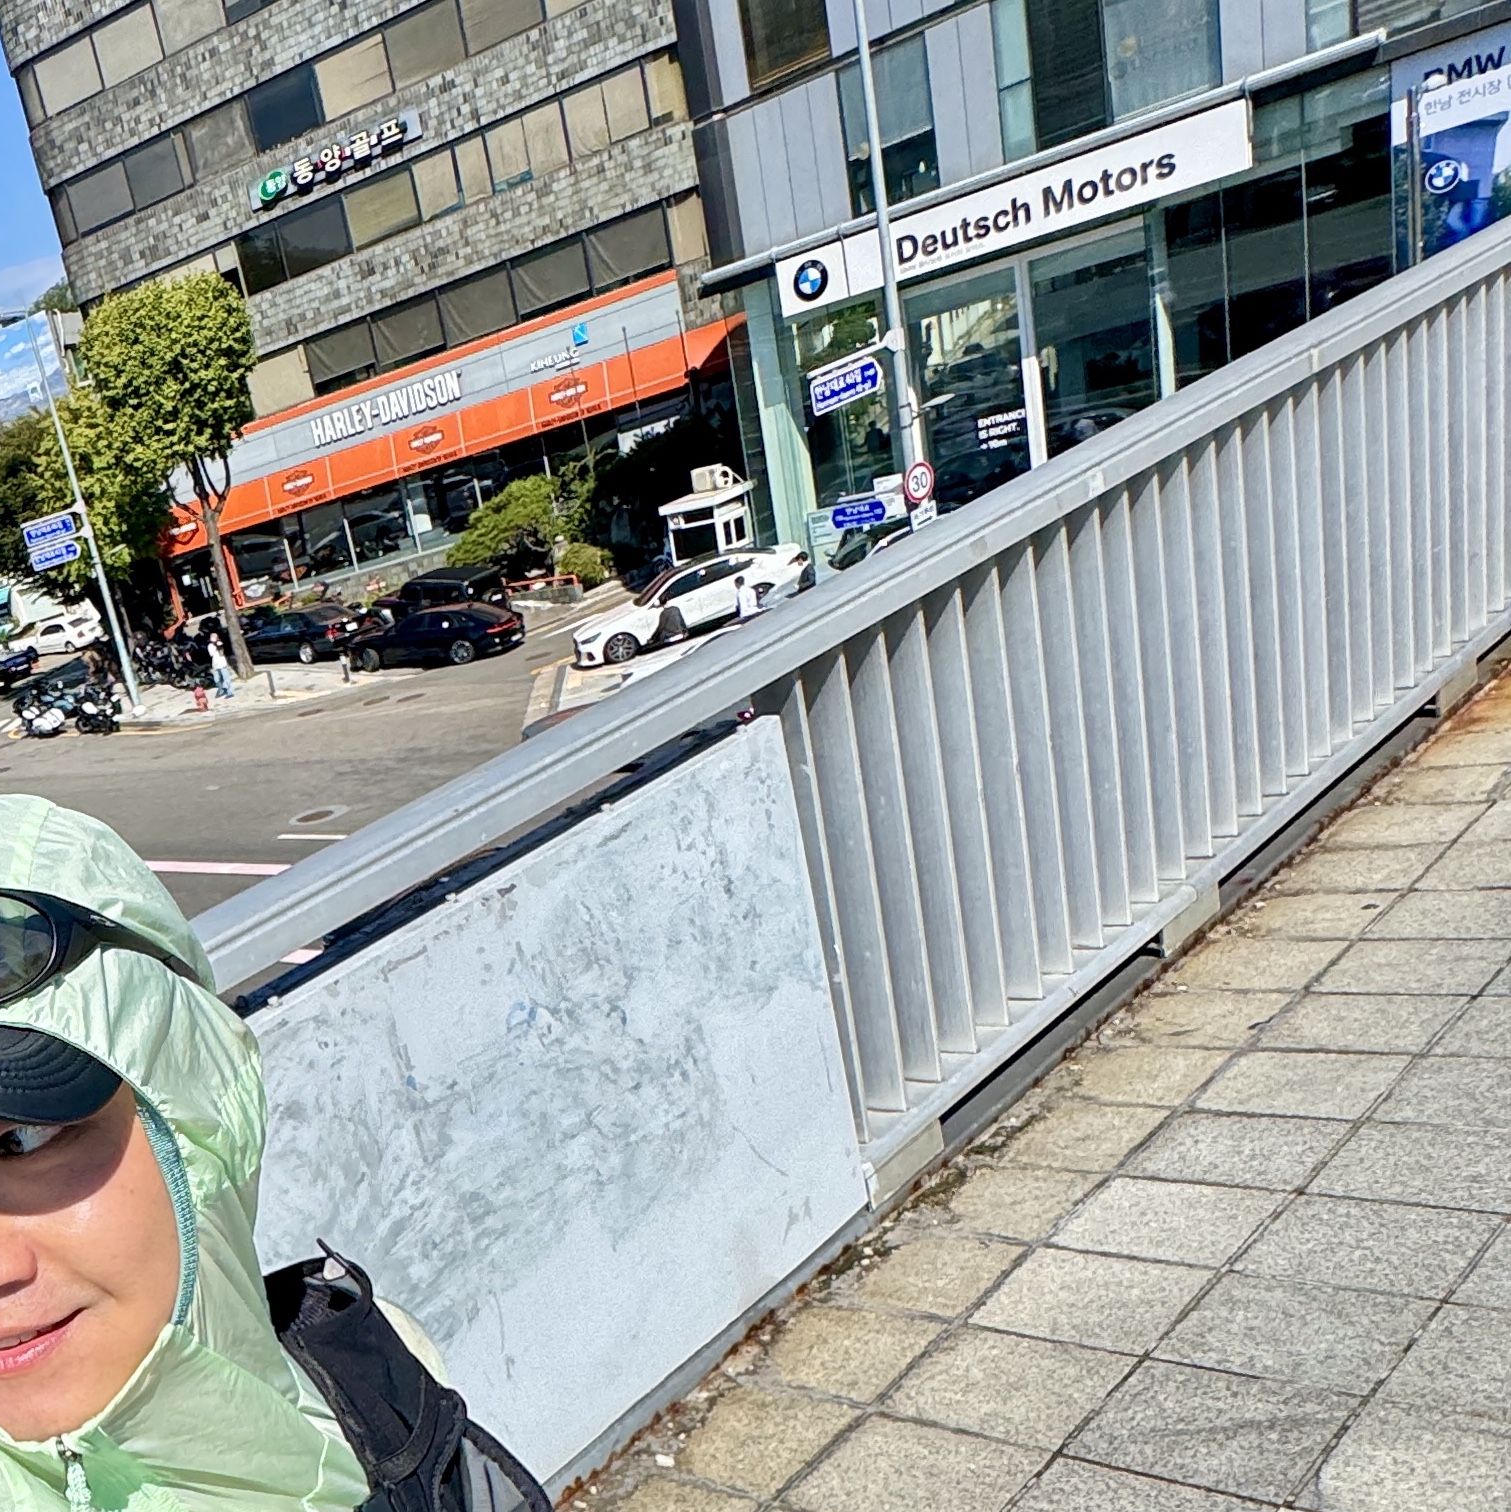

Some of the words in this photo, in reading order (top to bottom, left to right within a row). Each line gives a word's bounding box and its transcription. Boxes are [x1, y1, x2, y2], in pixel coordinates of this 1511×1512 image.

[1423, 95, 1452, 116] 한남
[1457, 78, 1502, 105] 전시장
[292, 118, 404, 185] 동양골프
[895, 197, 1031, 267] Deutsch
[1042, 152, 1178, 219] Motors
[310, 370, 462, 447] HARLEY-DAVIDSON
[911, 471, 929, 493] 30
